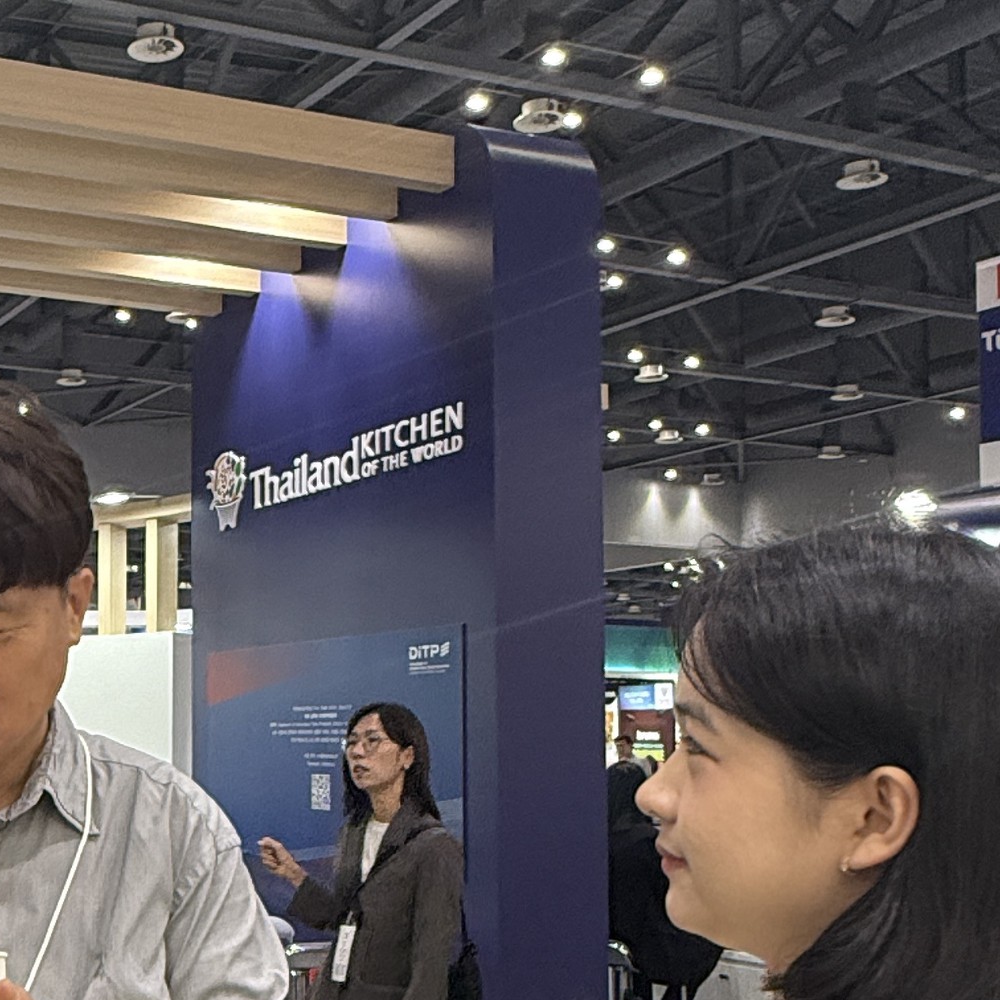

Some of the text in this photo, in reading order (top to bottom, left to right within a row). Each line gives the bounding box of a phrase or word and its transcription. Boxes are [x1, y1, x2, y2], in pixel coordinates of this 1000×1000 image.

[249, 401, 463, 510] Thailand KITCHEN
[361, 435, 463, 478] OF THE WORLD
